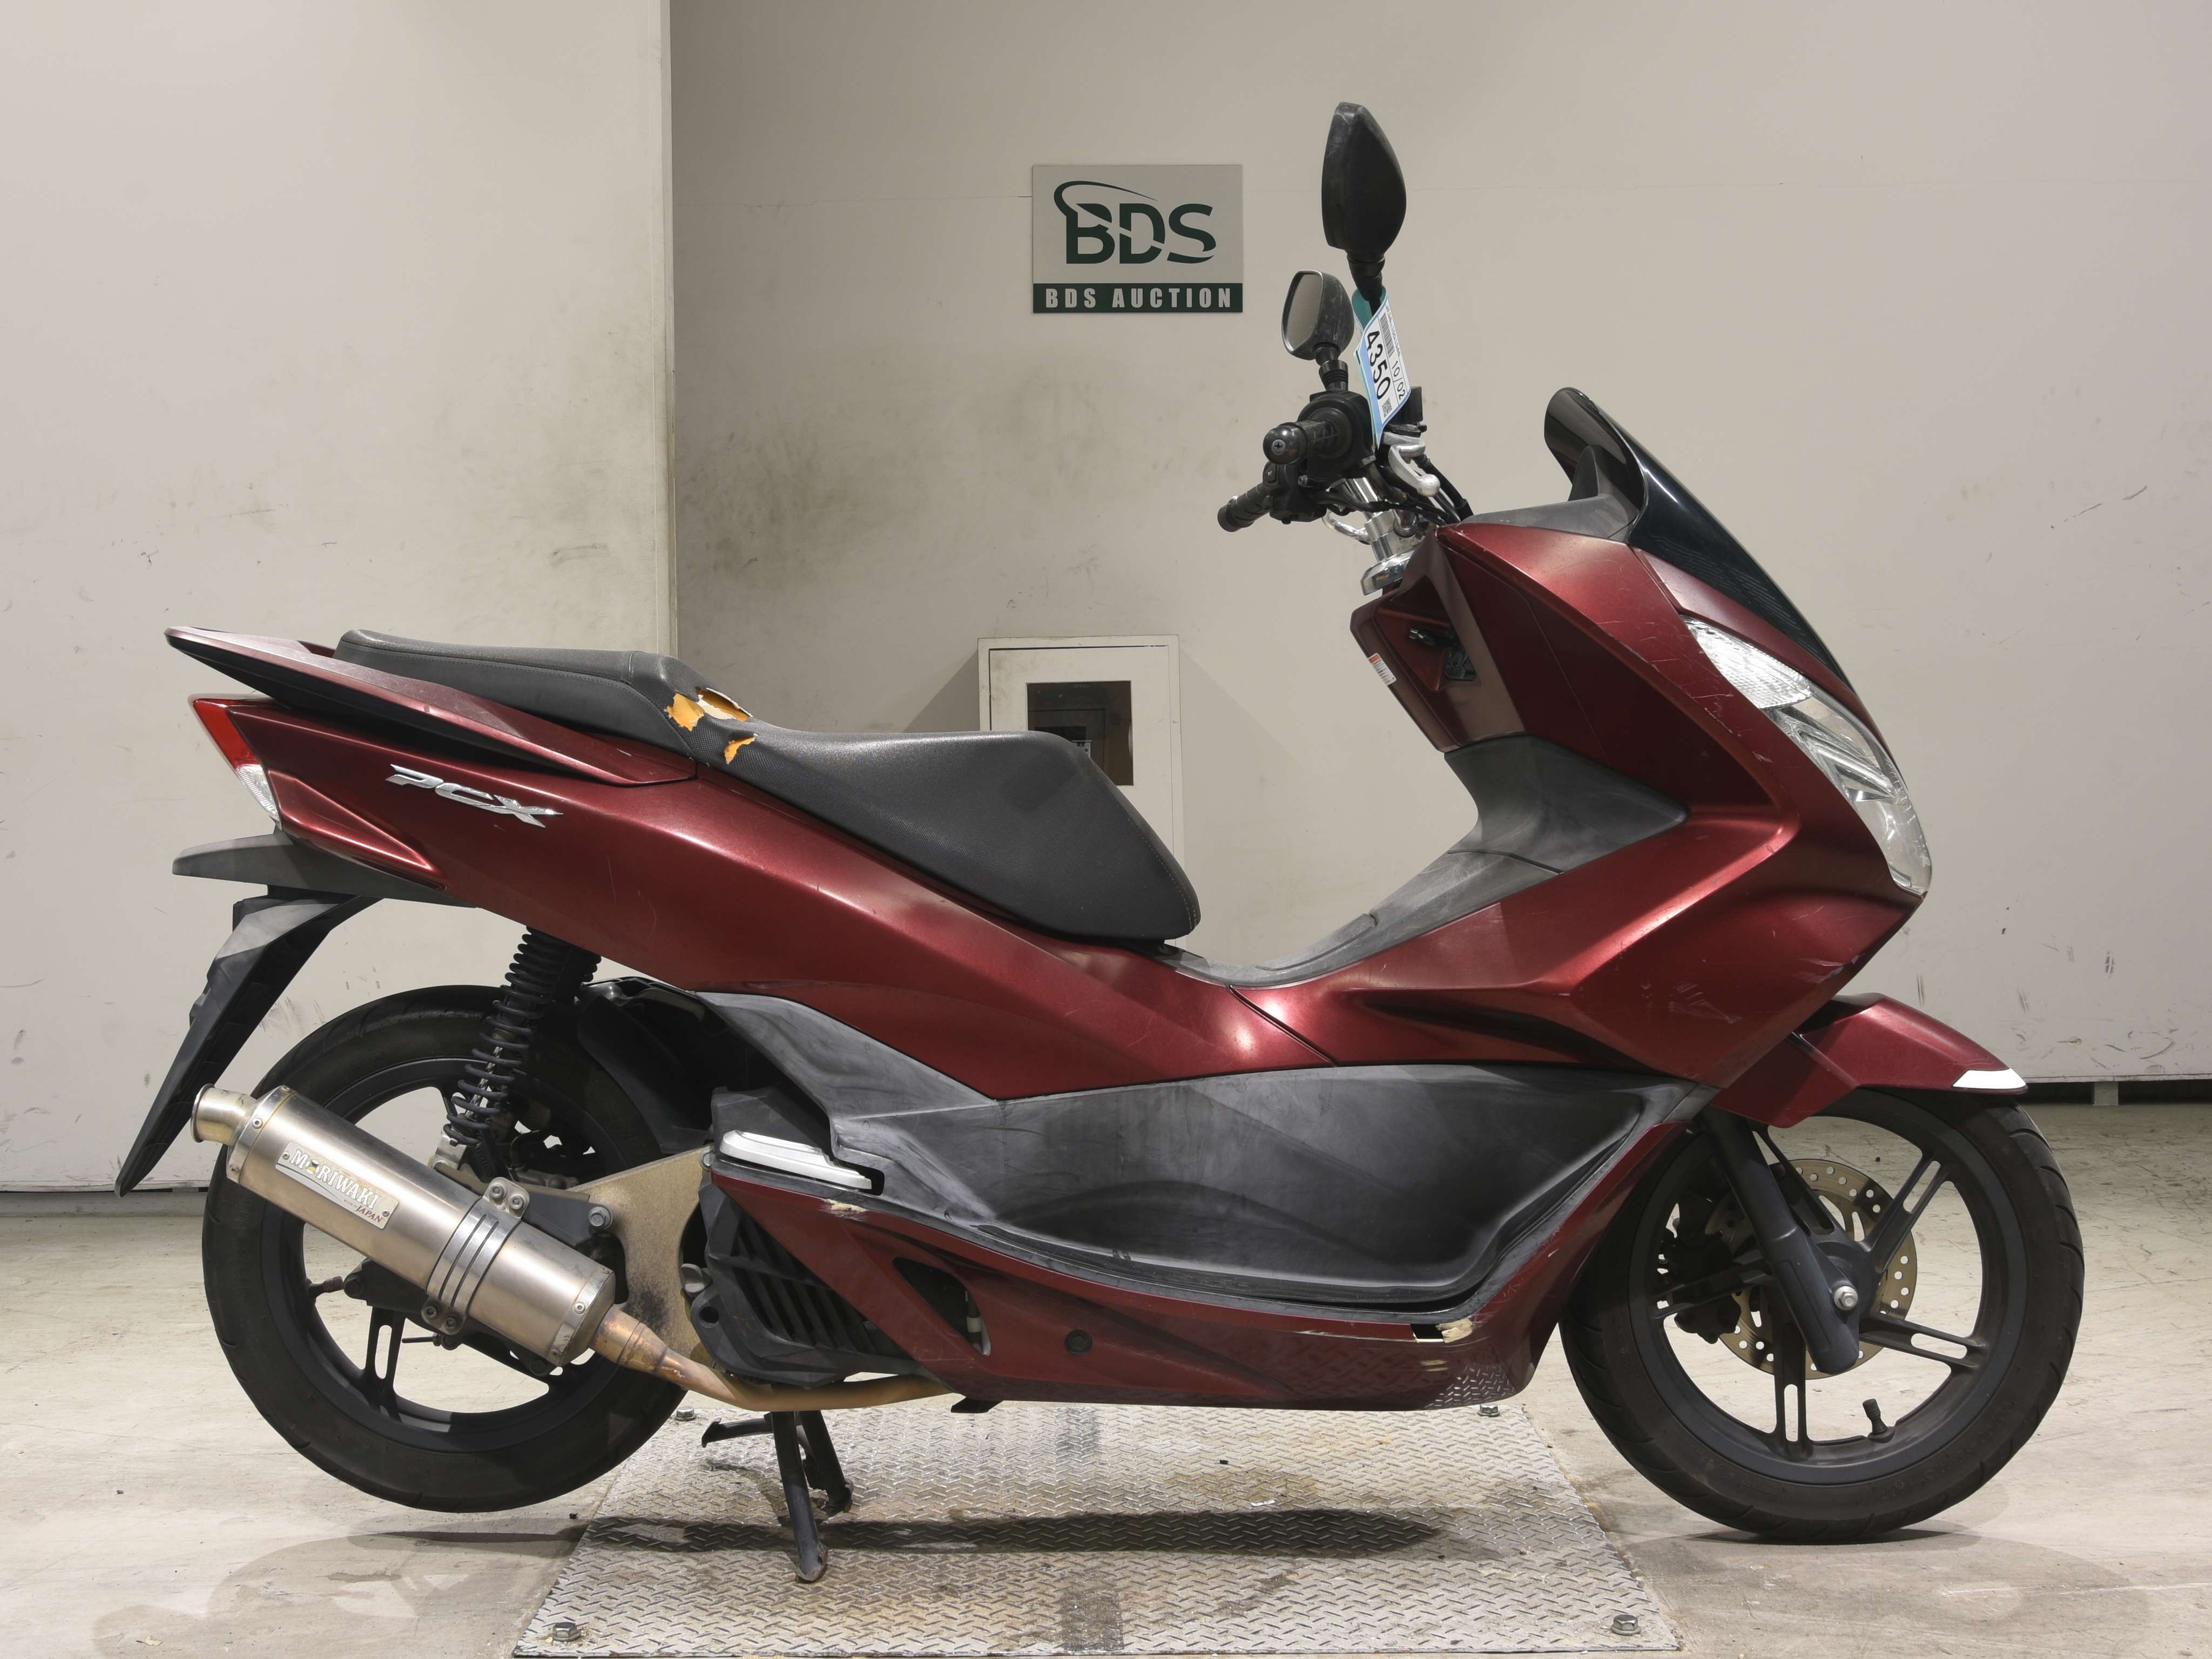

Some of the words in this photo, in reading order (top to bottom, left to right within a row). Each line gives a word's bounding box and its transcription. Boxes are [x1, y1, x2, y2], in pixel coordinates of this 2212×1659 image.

[1054, 180, 1216, 264] BDS
[1046, 288, 1096, 308] BDS
[1112, 288, 1231, 308] AUCTION
[1367, 331, 1391, 400] 4350
[385, 764, 563, 828] PCX
[290, 1149, 379, 1210] MORIWAKI
[354, 1205, 383, 1223] JAPAN
